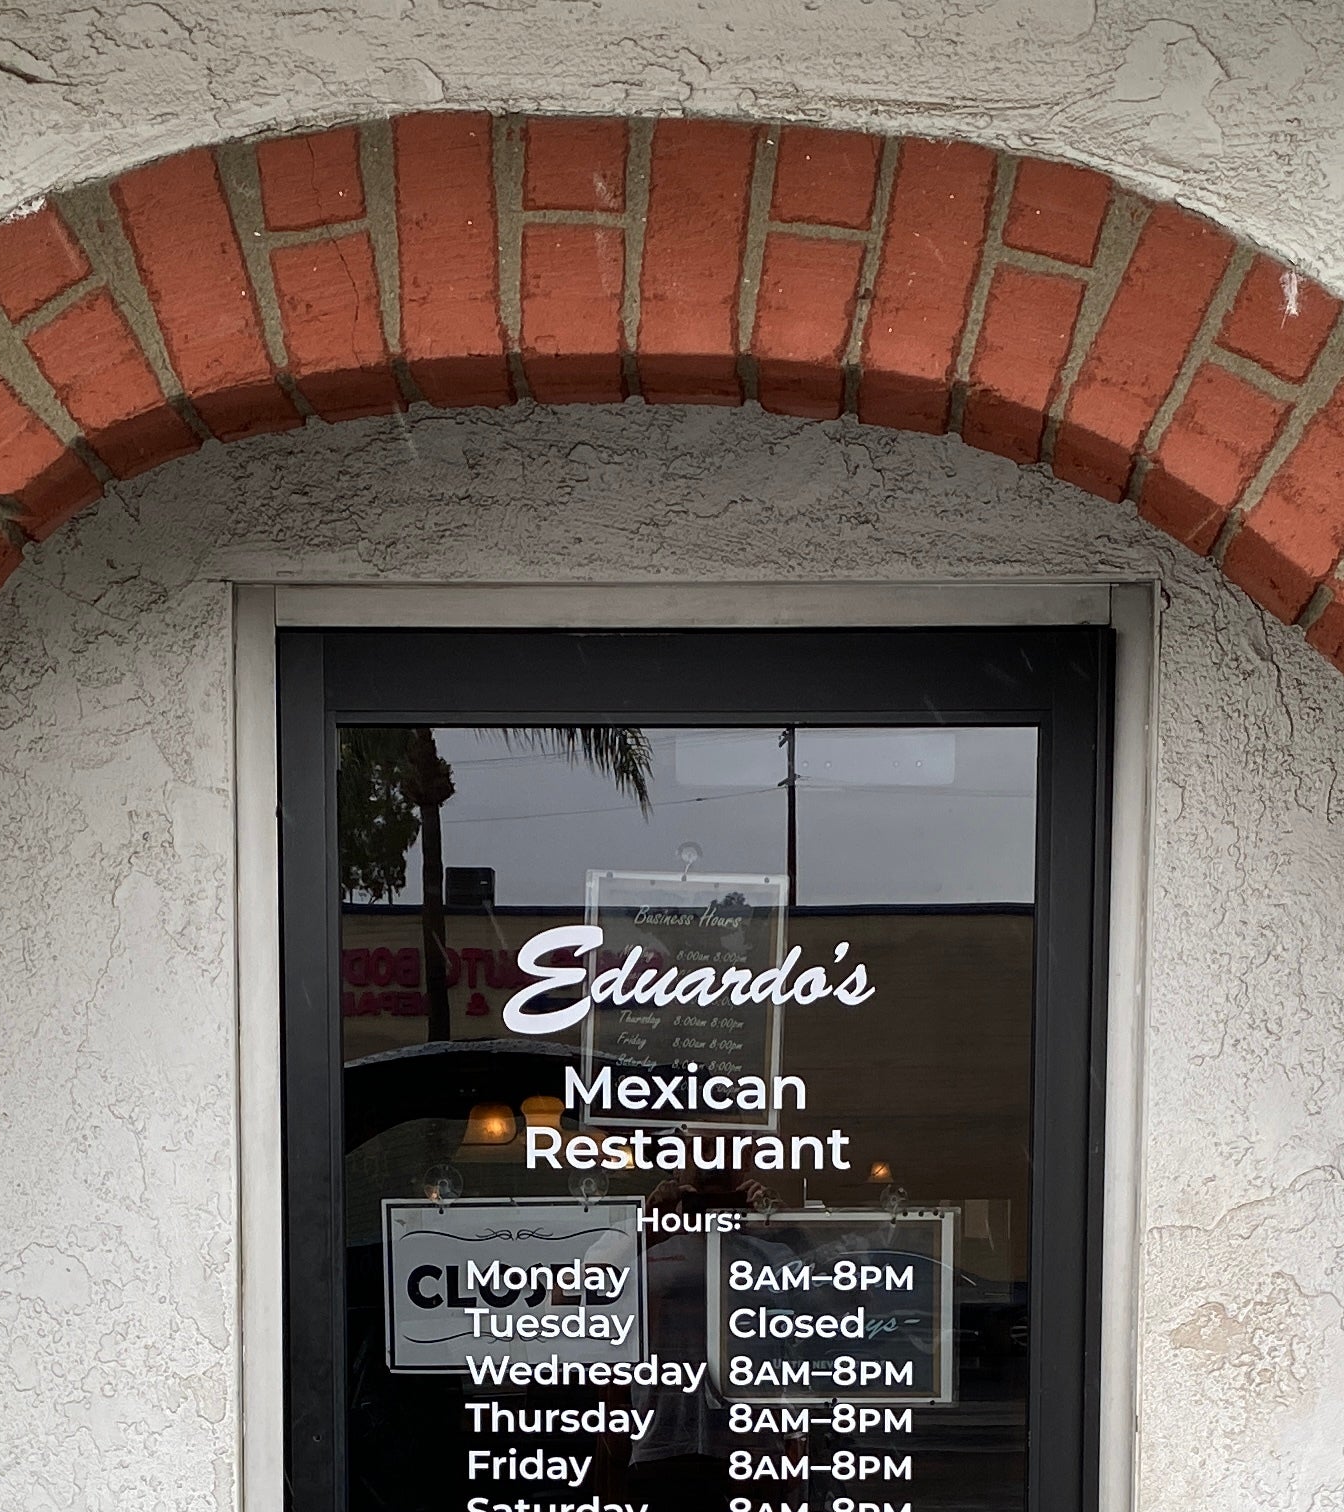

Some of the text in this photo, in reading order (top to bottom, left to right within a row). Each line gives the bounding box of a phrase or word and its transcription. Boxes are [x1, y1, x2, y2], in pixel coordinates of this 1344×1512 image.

[633, 904, 743, 929] Business Hours
[502, 925, 876, 1035] Eduardo's
[618, 1009, 662, 1029] Thursday
[616, 1031, 648, 1050] Friday
[565, 1063, 806, 1110] Mexican
[526, 1126, 851, 1170] Restaurant
[636, 1206, 741, 1233] Hours:
[467, 1258, 631, 1298] Monday
[464, 1306, 635, 1346] Tuesday
[729, 1306, 865, 1339] Closed
[465, 1354, 707, 1393] Wednesday
[464, 1401, 655, 1440] Thursday
[468, 1447, 593, 1487] Friday
